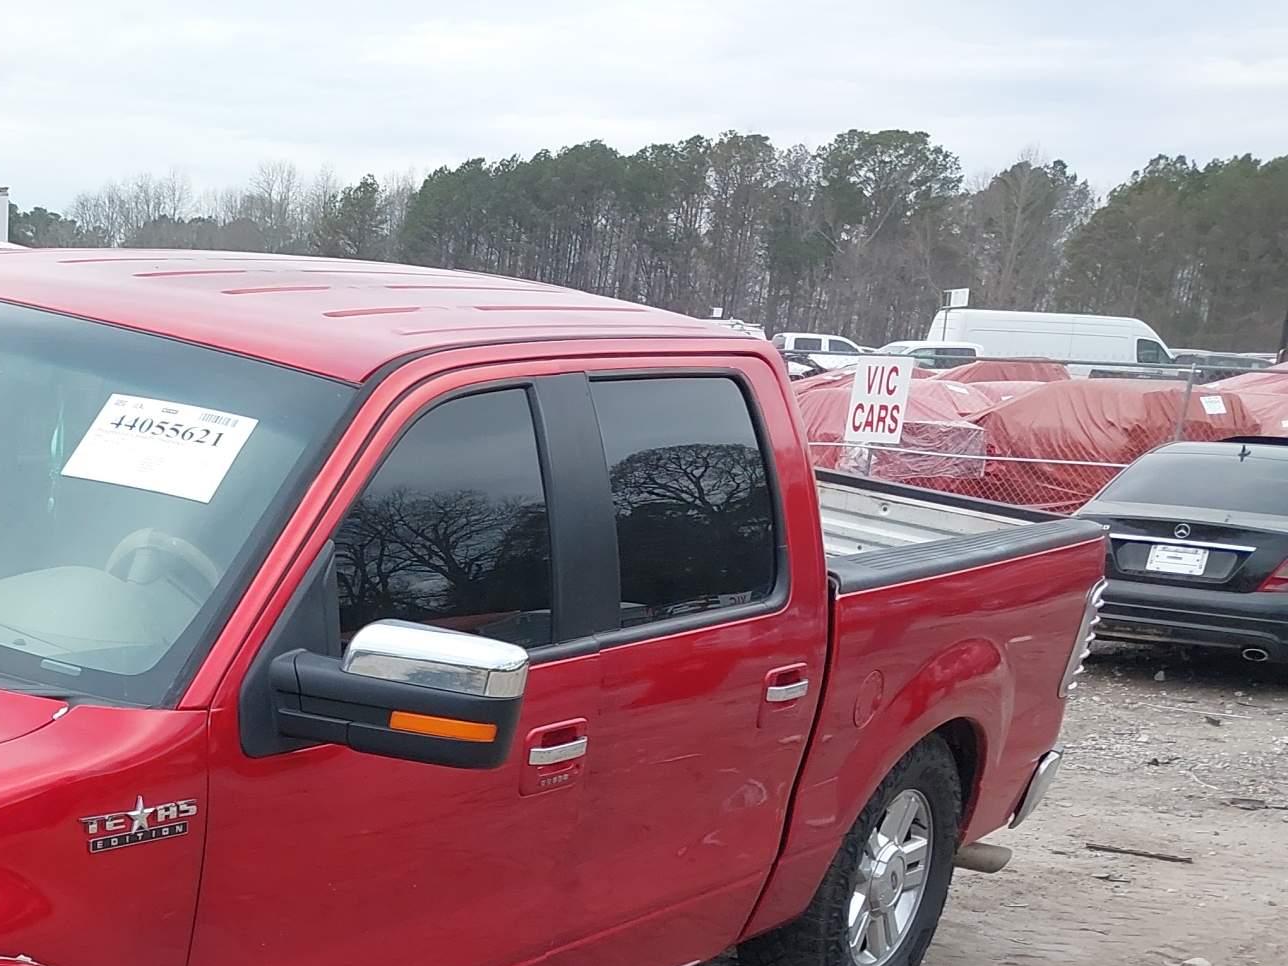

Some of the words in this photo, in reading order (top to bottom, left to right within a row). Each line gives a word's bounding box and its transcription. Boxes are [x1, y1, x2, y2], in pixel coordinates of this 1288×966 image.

[867, 365, 900, 396] VIC
[109, 413, 225, 447] 44055621
[852, 402, 901, 434] CARS
[79, 795, 198, 834] TEXAS
[96, 823, 184, 850] EDITION
